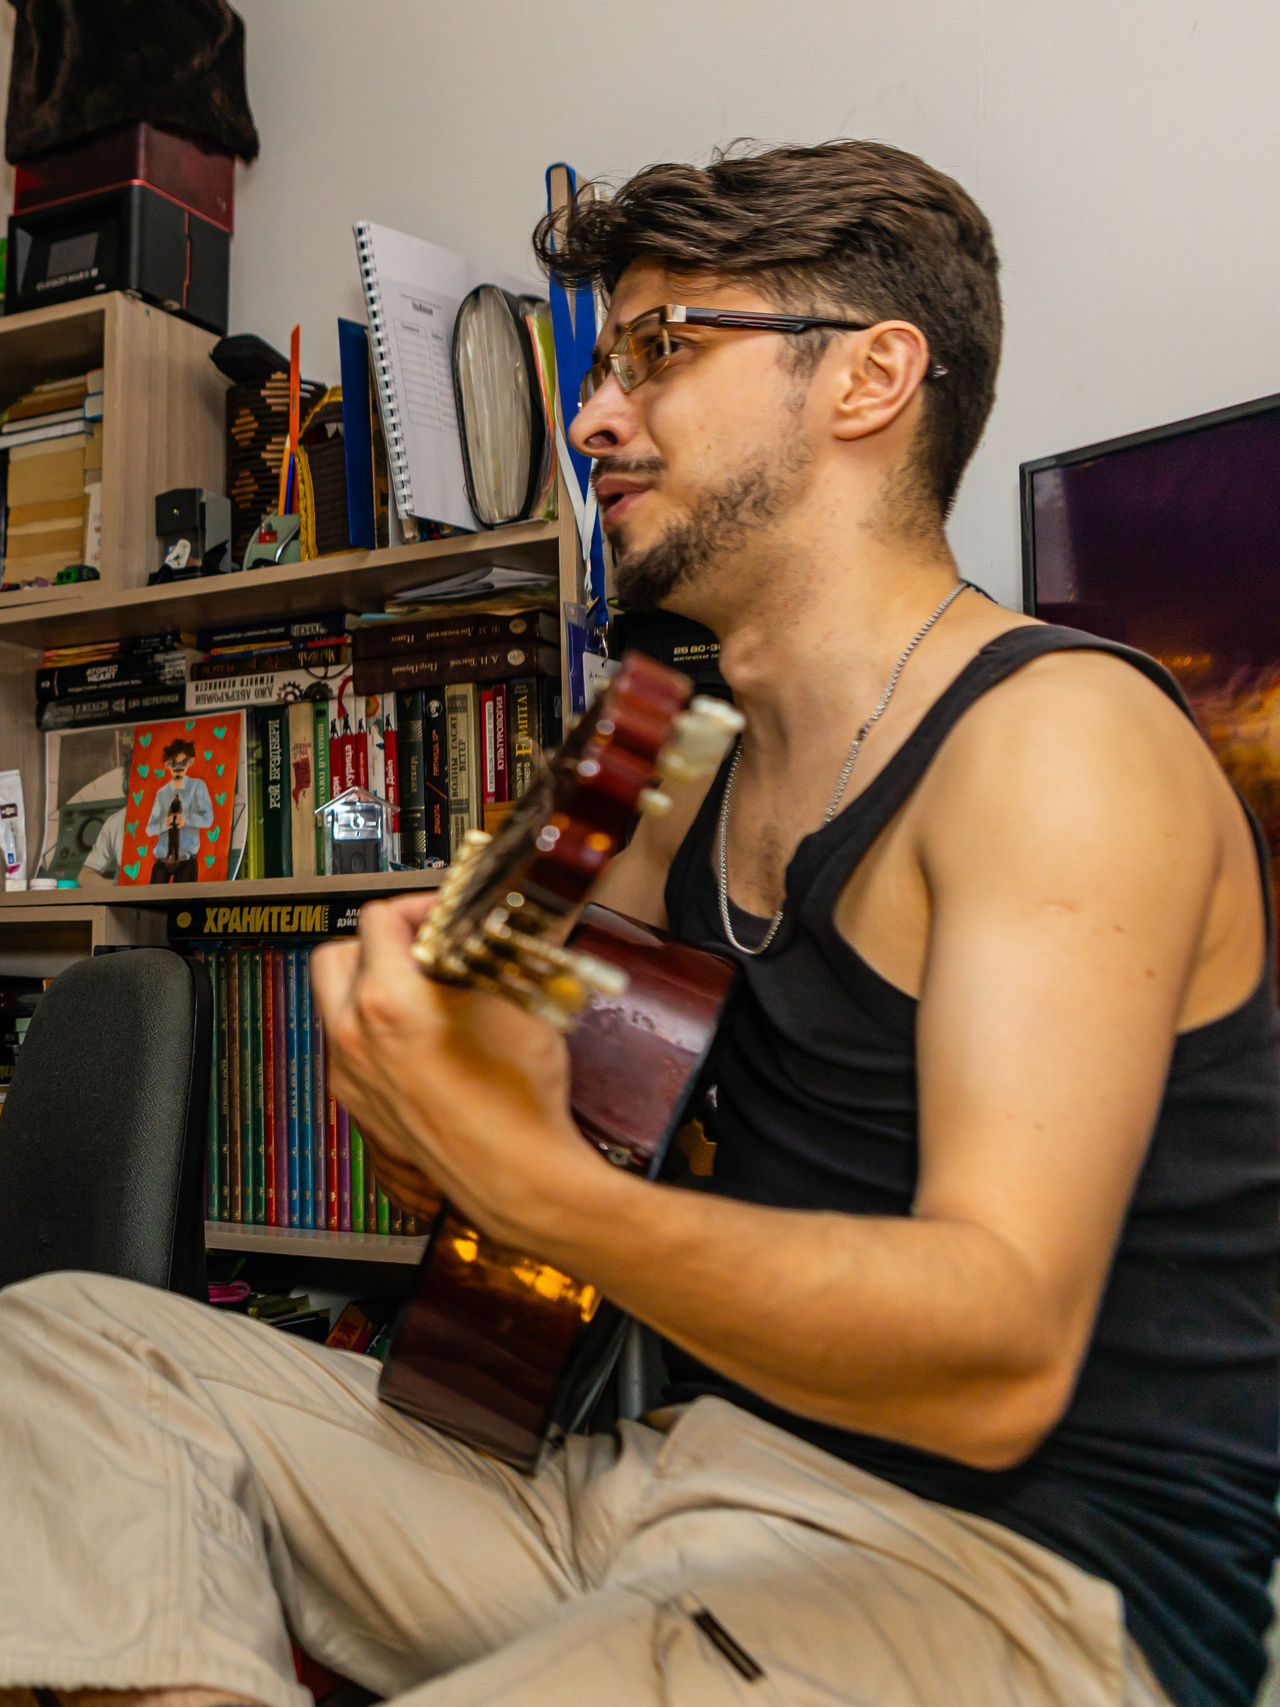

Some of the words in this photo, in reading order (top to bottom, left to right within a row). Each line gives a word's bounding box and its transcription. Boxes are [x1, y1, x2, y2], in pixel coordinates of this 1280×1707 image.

[391, 634, 415, 643] Идиот
[426, 627, 474, 640] Достоевский
[449, 657, 477, 668] Толстой
[86, 665, 118, 676] ATOMIC
[88, 671, 117, 682] HEART
[195, 680, 236, 692] НЕНАВИСТИ
[240, 674, 274, 686] НЕМНОГО
[195, 689, 251, 706] АБЕРКРОМБИ
[254, 685, 274, 698] ДЖО
[450, 715, 458, 750] ГАСЯТ
[496, 696, 504, 770] КУЛЬТУРОЛОГИЯ
[268, 719, 282, 780] БРЭДБЕРИ
[318, 724, 326, 768] НИКОЛАЙ
[344, 744, 354, 787] курица
[386, 759, 395, 784] Дойл
[268, 784, 281, 809] РЭЙ
[203, 905, 322, 933] ХРАНИТЕЛИ
[346, 909, 361, 917] АЛА
